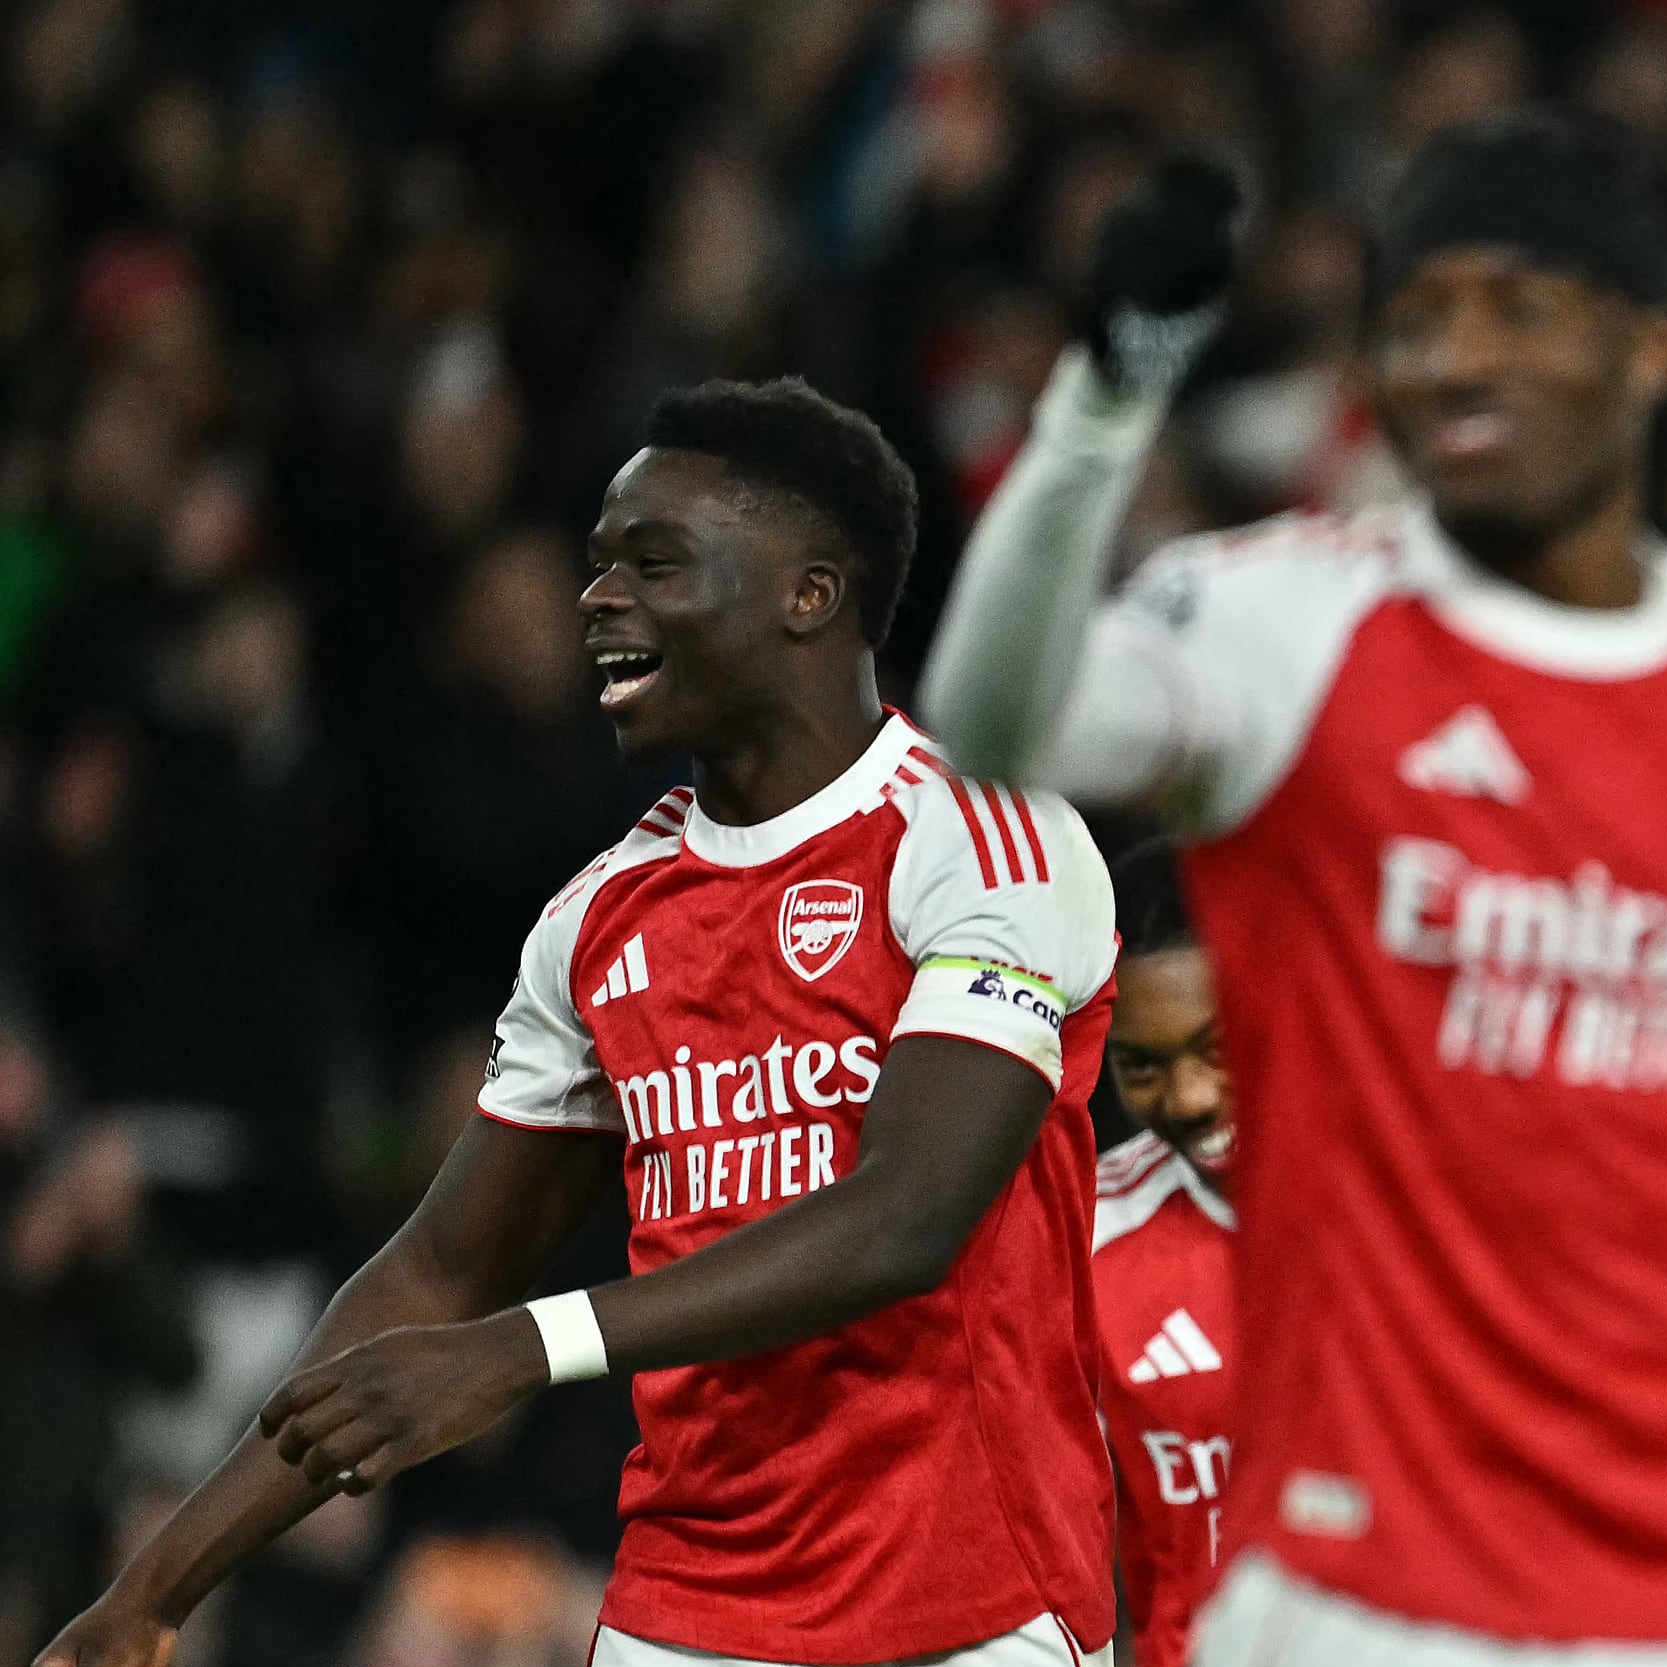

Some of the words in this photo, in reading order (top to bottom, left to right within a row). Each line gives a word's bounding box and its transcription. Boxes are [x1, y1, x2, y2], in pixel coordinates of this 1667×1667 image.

[793, 898, 851, 916] Arsenal
[614, 1033, 882, 1145] mirates
[639, 1150, 672, 1221] FLY
[686, 1122, 836, 1214] BETTER
